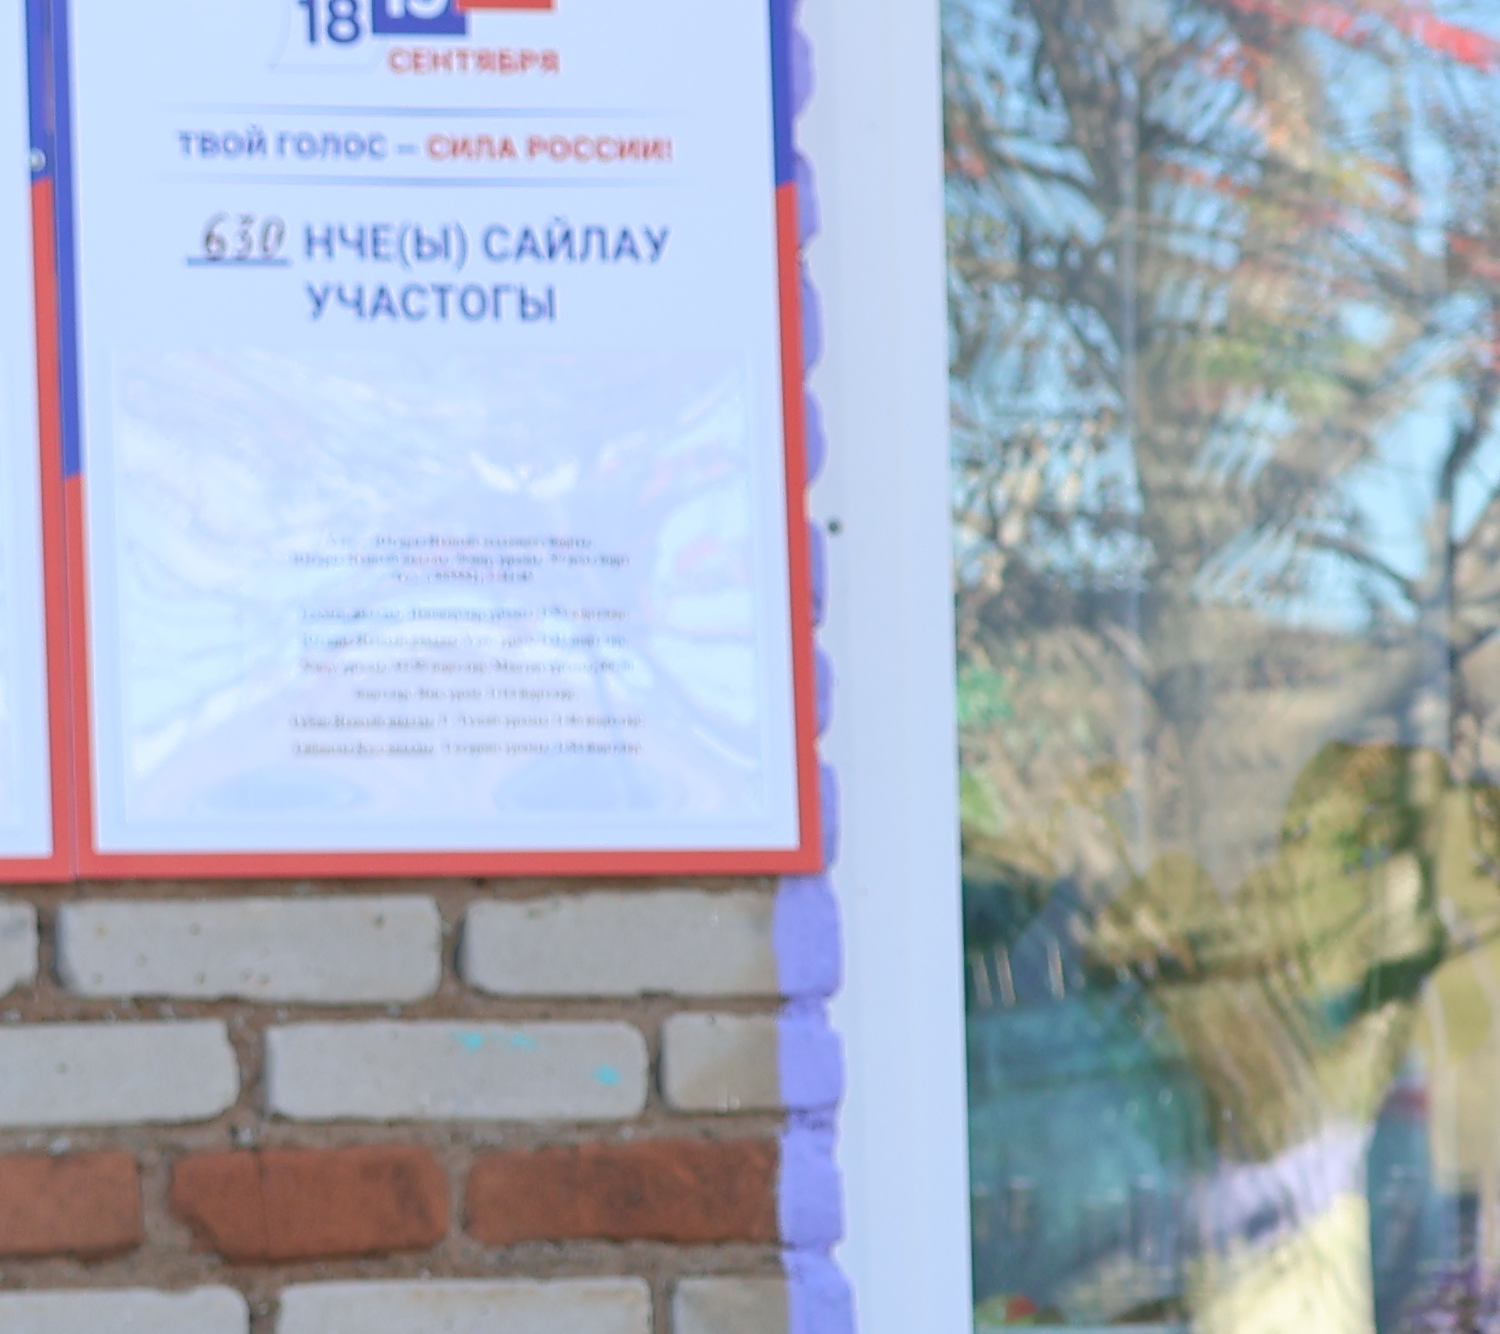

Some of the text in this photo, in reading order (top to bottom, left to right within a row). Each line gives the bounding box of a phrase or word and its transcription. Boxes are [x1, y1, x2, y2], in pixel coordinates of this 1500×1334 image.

[389, 49, 559, 74] СЕНТЯБРЯ
[179, 126, 266, 158] ТВОЙ
[277, 132, 386, 160] ГОЛОС
[427, 135, 516, 159] СИЛА
[527, 136, 671, 160] РОССИИ!
[305, 224, 467, 269] НЧЕ(Ы)
[483, 217, 668, 262] САЙЛАУ
[307, 284, 556, 322] УЧАСТОГЫ
